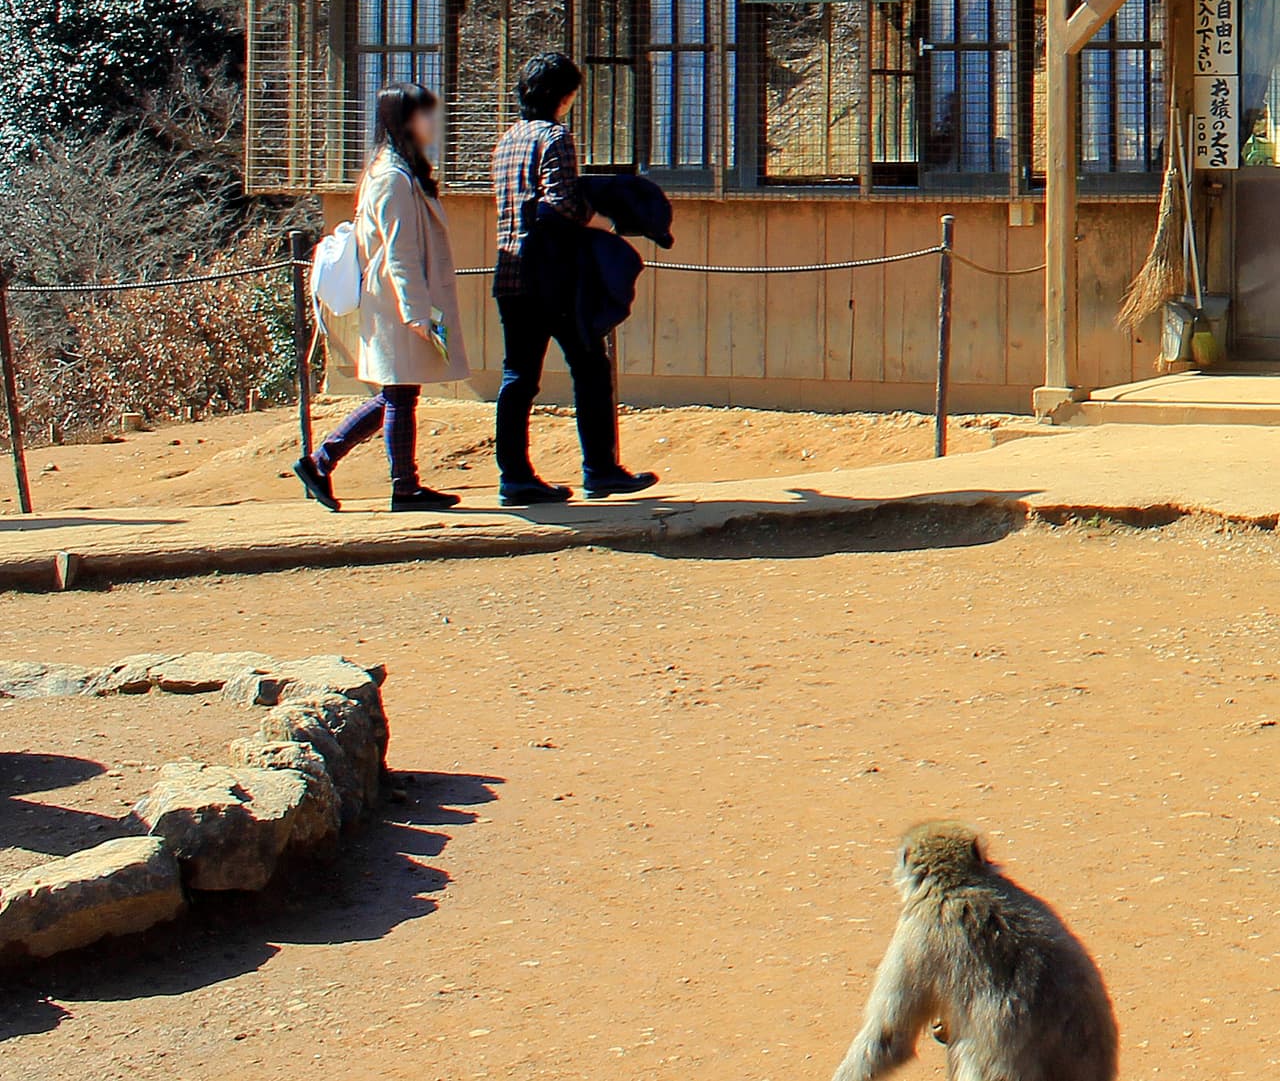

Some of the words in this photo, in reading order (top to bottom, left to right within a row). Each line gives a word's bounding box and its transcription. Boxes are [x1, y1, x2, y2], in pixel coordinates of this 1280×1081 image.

[1209, 78, 1232, 167] お猿のえさ
